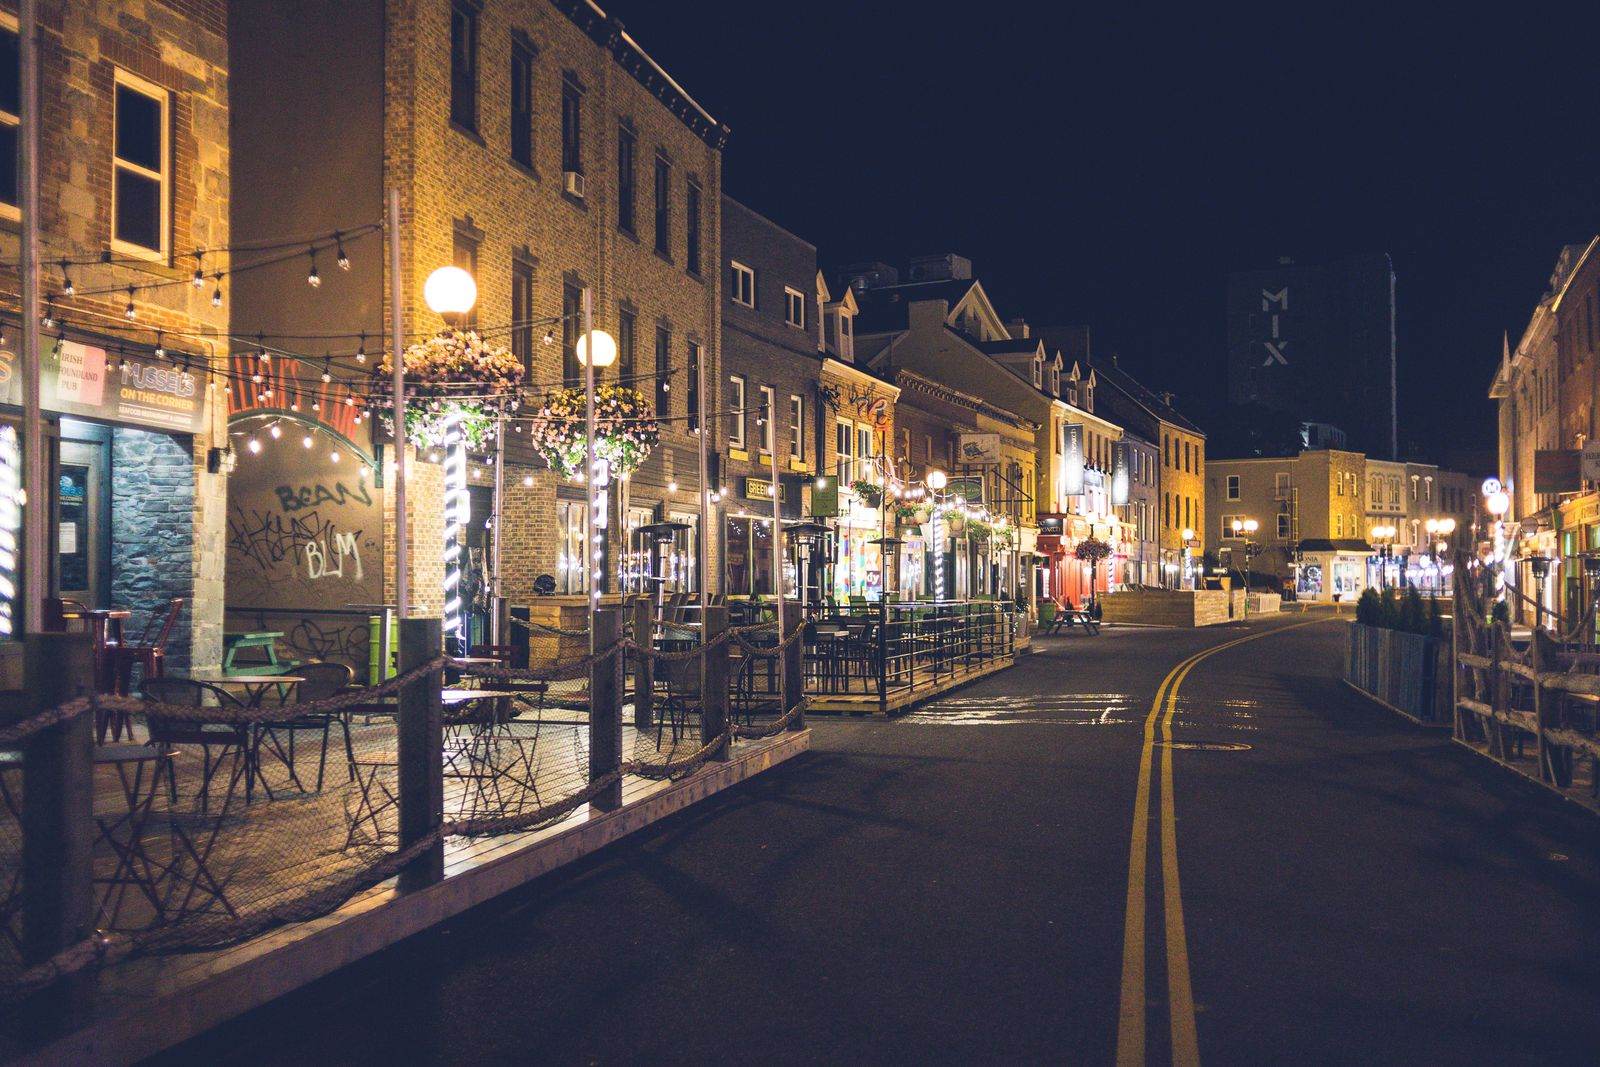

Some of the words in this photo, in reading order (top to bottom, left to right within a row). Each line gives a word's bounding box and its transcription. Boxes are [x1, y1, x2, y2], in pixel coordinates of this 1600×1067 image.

[1262, 287, 1288, 367] MIX
[61, 353, 83, 365] IRISH
[62, 380, 77, 391] PUB
[120, 361, 195, 397] MUSSELS
[120, 387, 136, 400] ON
[137, 390, 156, 403] THE
[157, 394, 194, 411] CORNER
[305, 532, 364, 580] BLM
